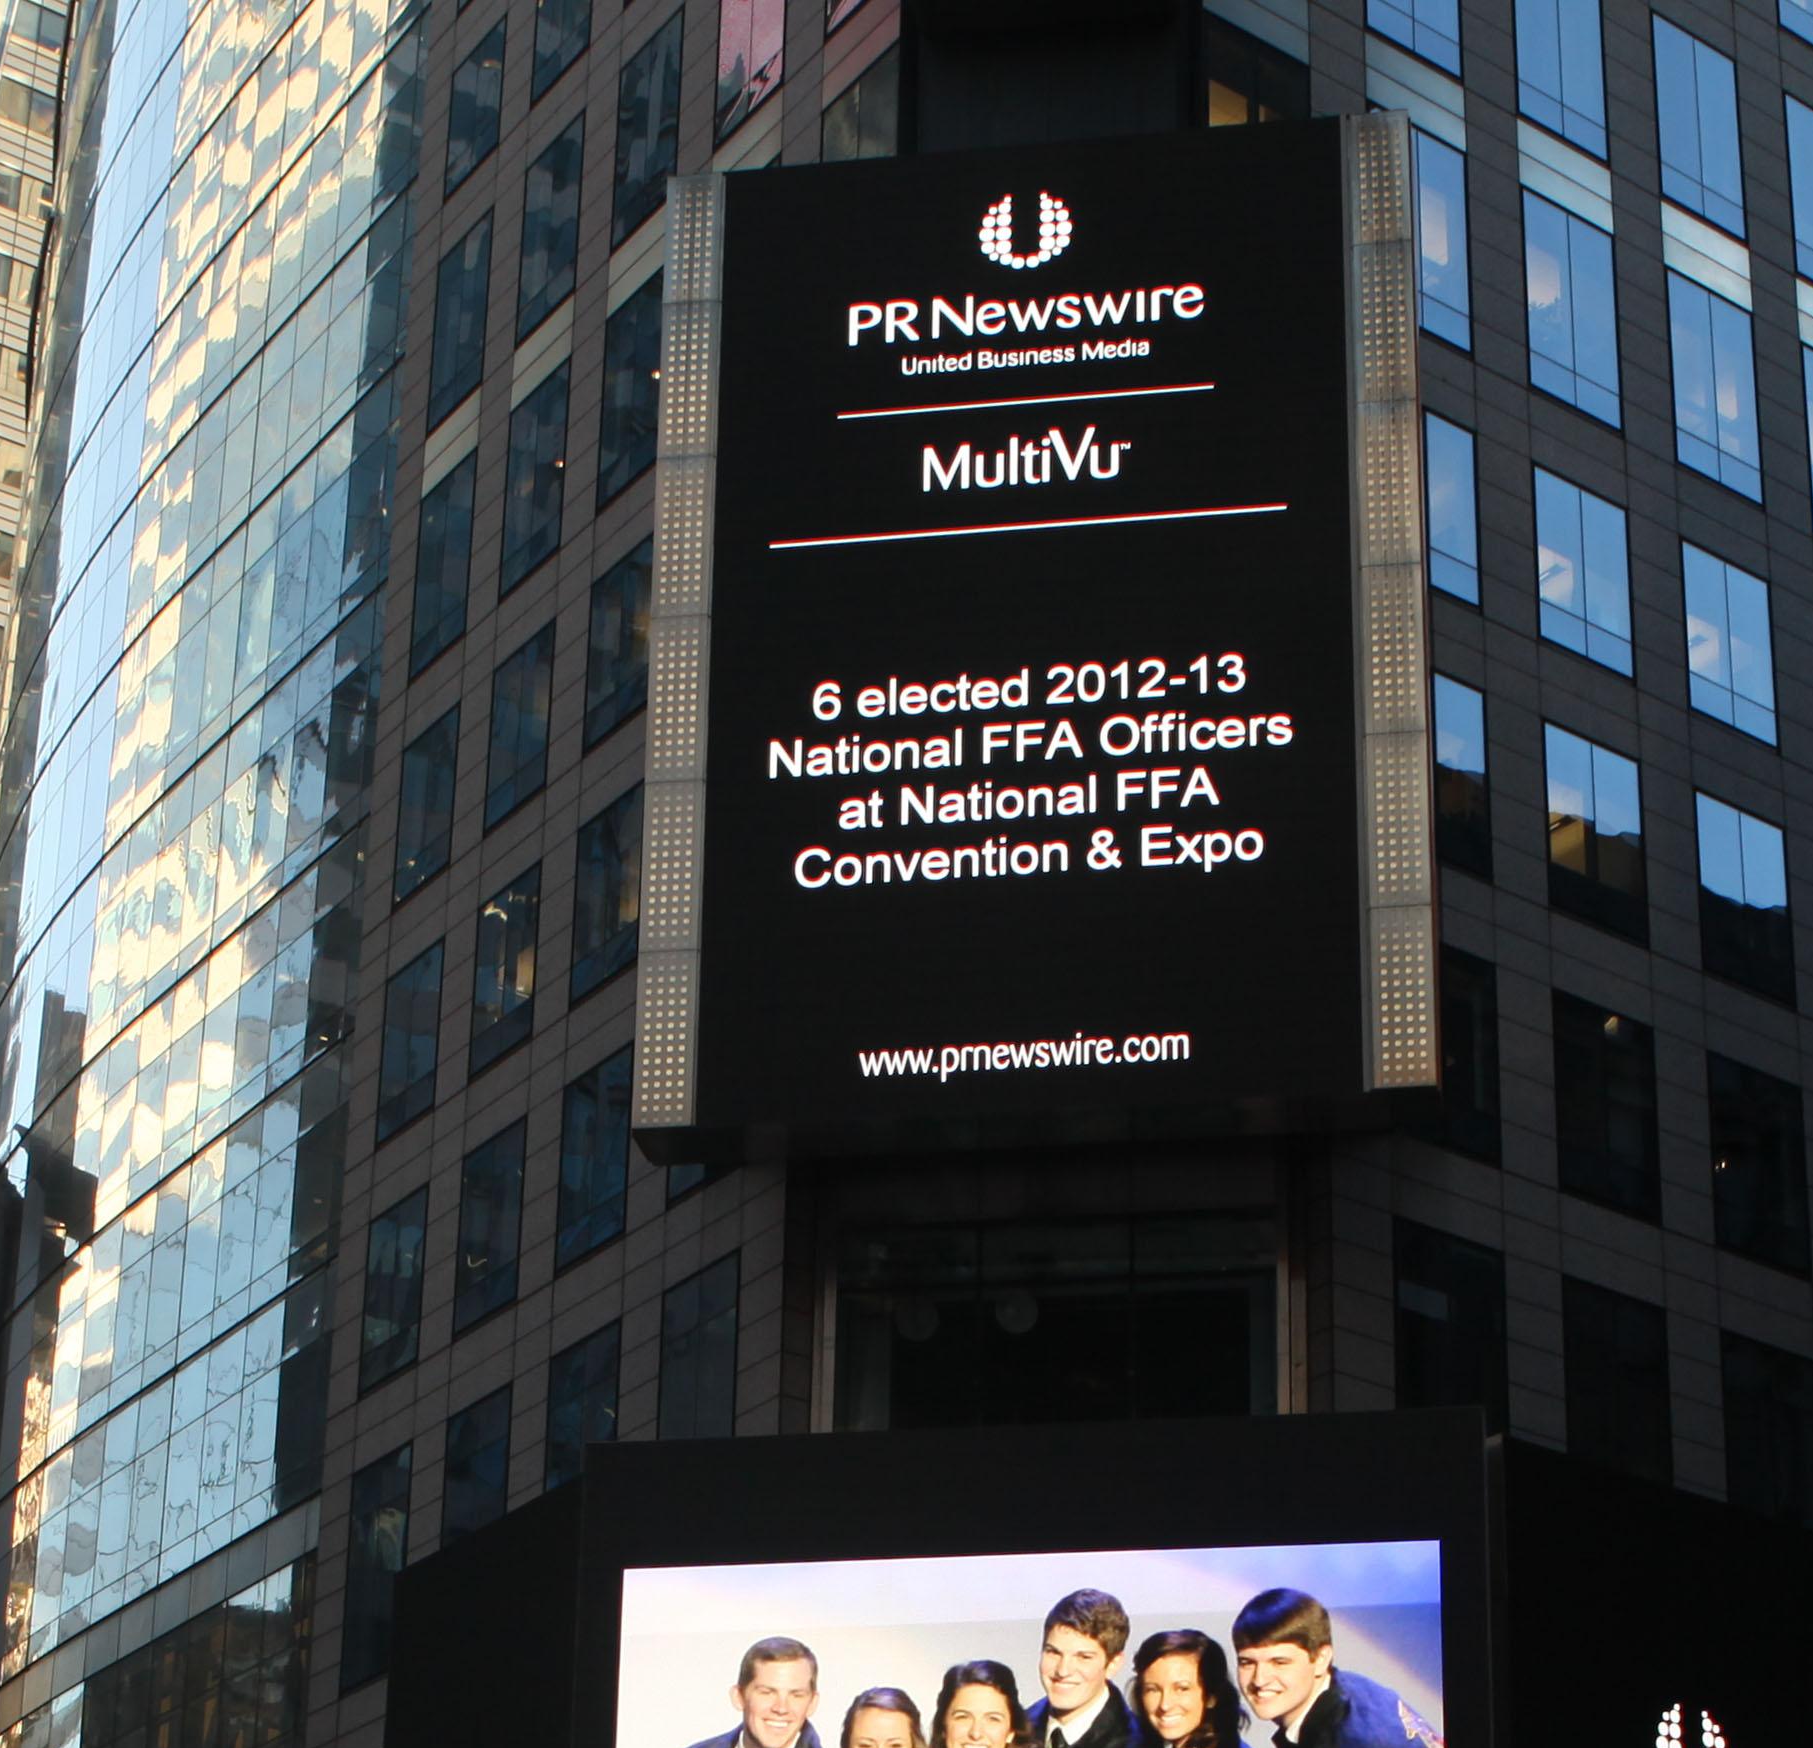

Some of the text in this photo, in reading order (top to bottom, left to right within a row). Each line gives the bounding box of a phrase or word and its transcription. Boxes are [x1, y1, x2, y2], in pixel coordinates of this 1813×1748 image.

[847, 282, 1206, 348] PR Newswire
[901, 338, 1151, 377] United Business Media
[811, 652, 1248, 722] 6 elected 2012-13
[767, 712, 1294, 780] National FFA Officers
[838, 767, 1220, 831] at National FFA
[794, 826, 1266, 890] Convention & Expo
[858, 1030, 1192, 1083] www.prnewswire.com
